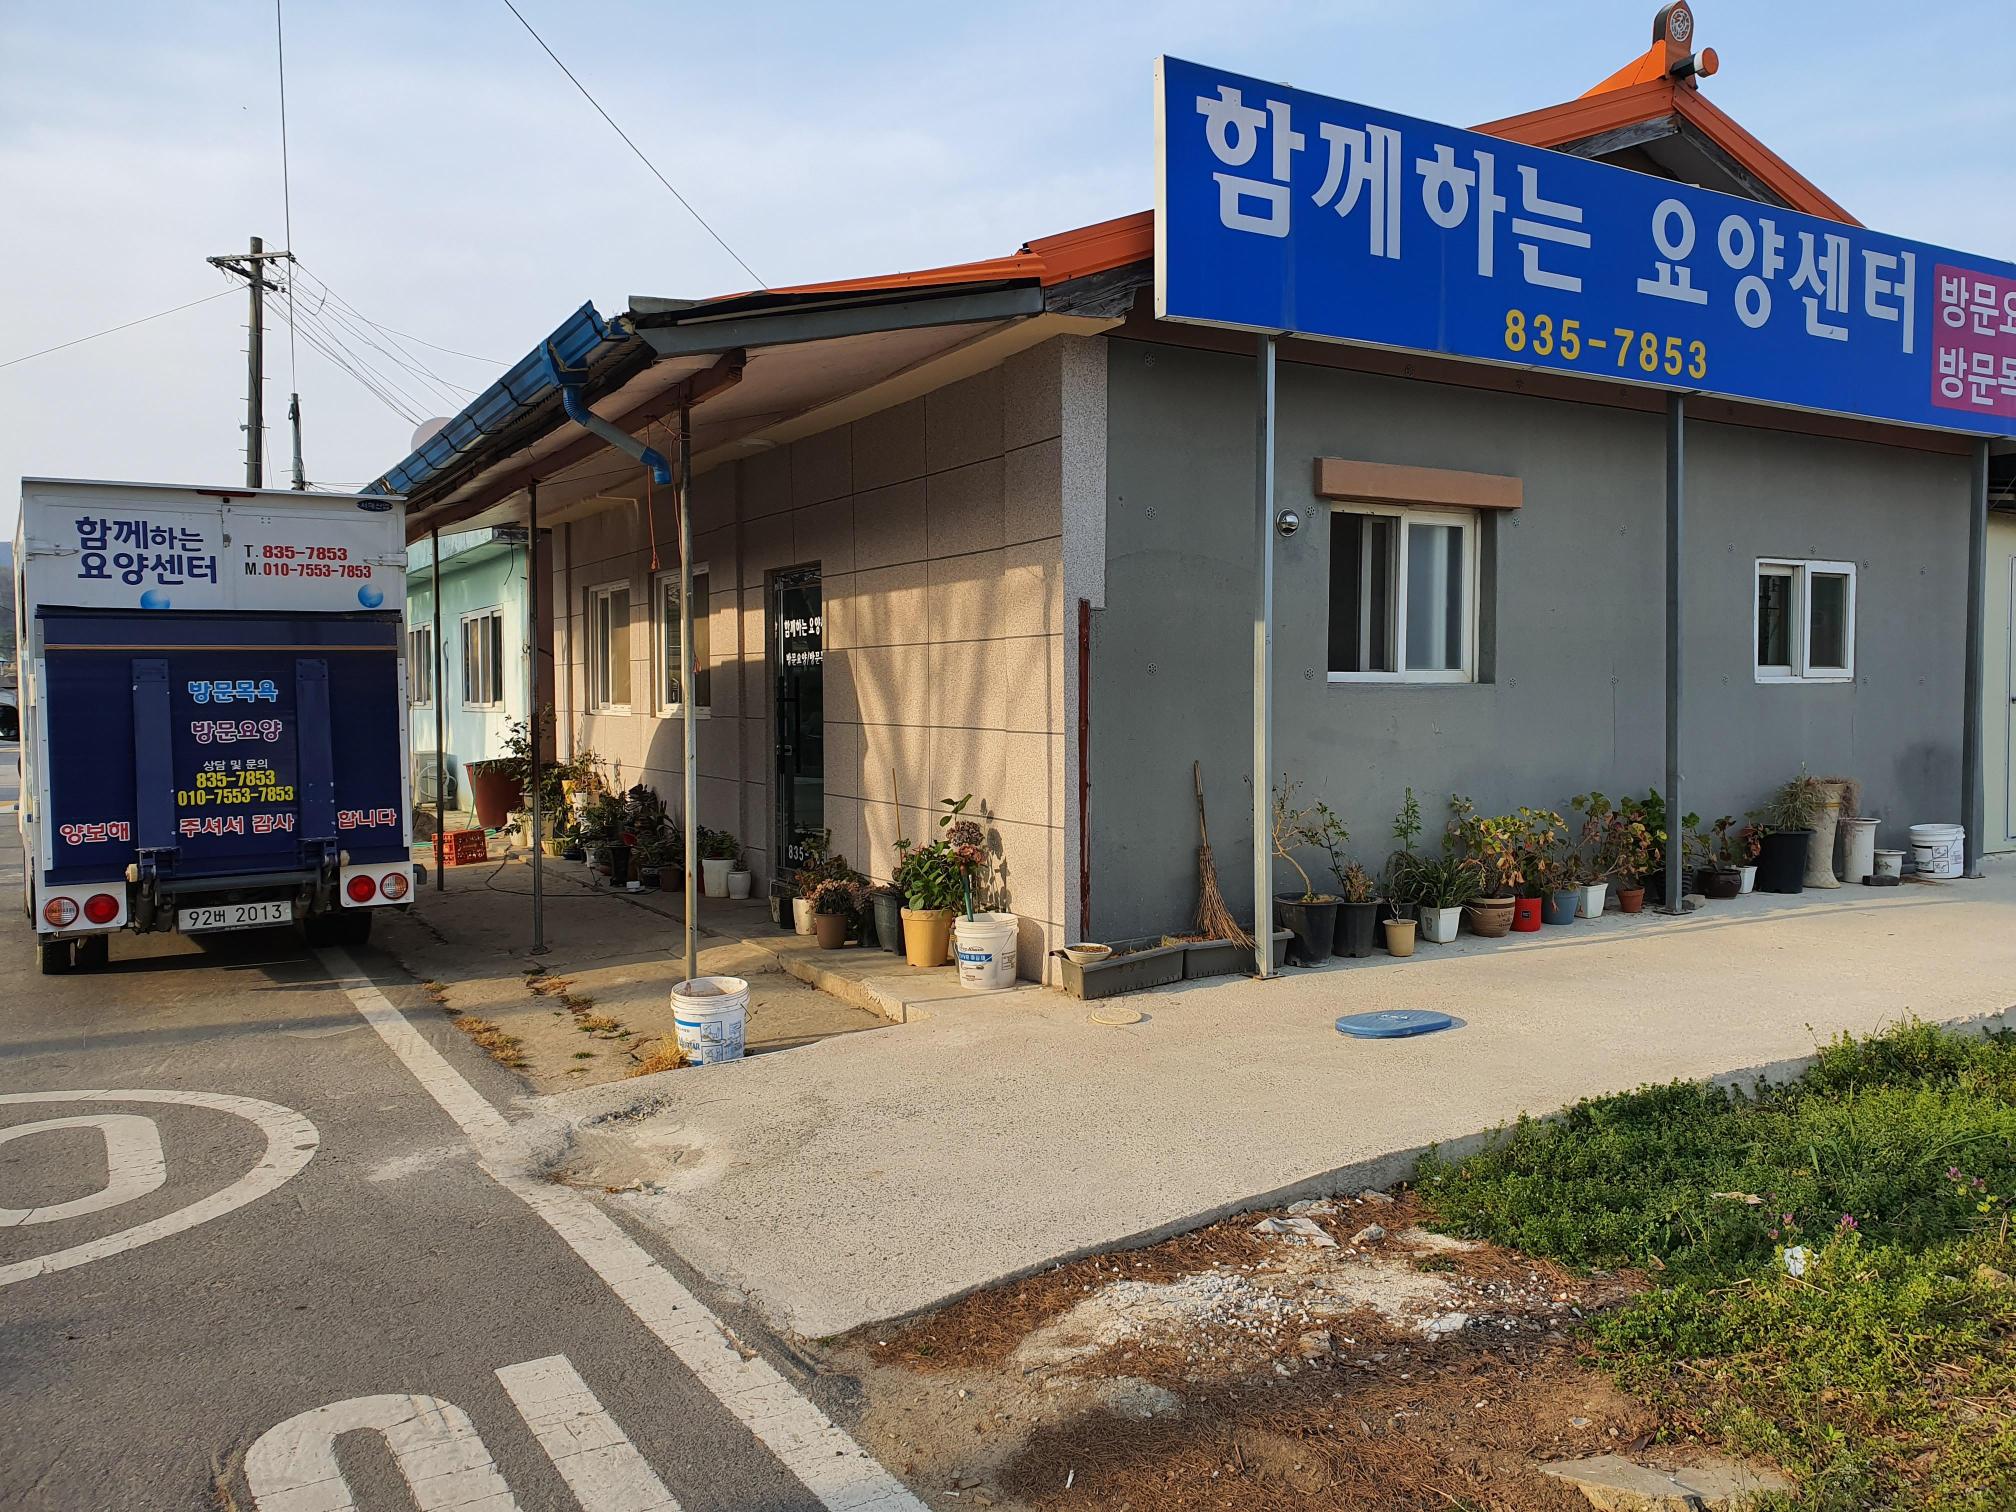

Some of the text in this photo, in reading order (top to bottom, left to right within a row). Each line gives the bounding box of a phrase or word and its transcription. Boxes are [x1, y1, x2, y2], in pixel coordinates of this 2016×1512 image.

[1196, 84, 1916, 354] 함께하는 요양센터
[1505, 308, 1707, 379] 835-7853
[75, 516, 204, 551] 함께하는
[262, 545, 348, 561] 835-7853
[77, 552, 217, 585] 요양센터
[263, 562, 372, 579] 010-7553-7853
[188, 680, 279, 704] 방문목욕
[191, 720, 282, 744] 방문요양
[203, 759, 268, 772] 상담 및 문의
[196, 770, 275, 788] 835-7853
[177, 786, 294, 806] 010-7553-7853
[59, 808, 397, 845] 양보해 주셔서 감사 합니다
[189, 904, 282, 927] 92버 2013
